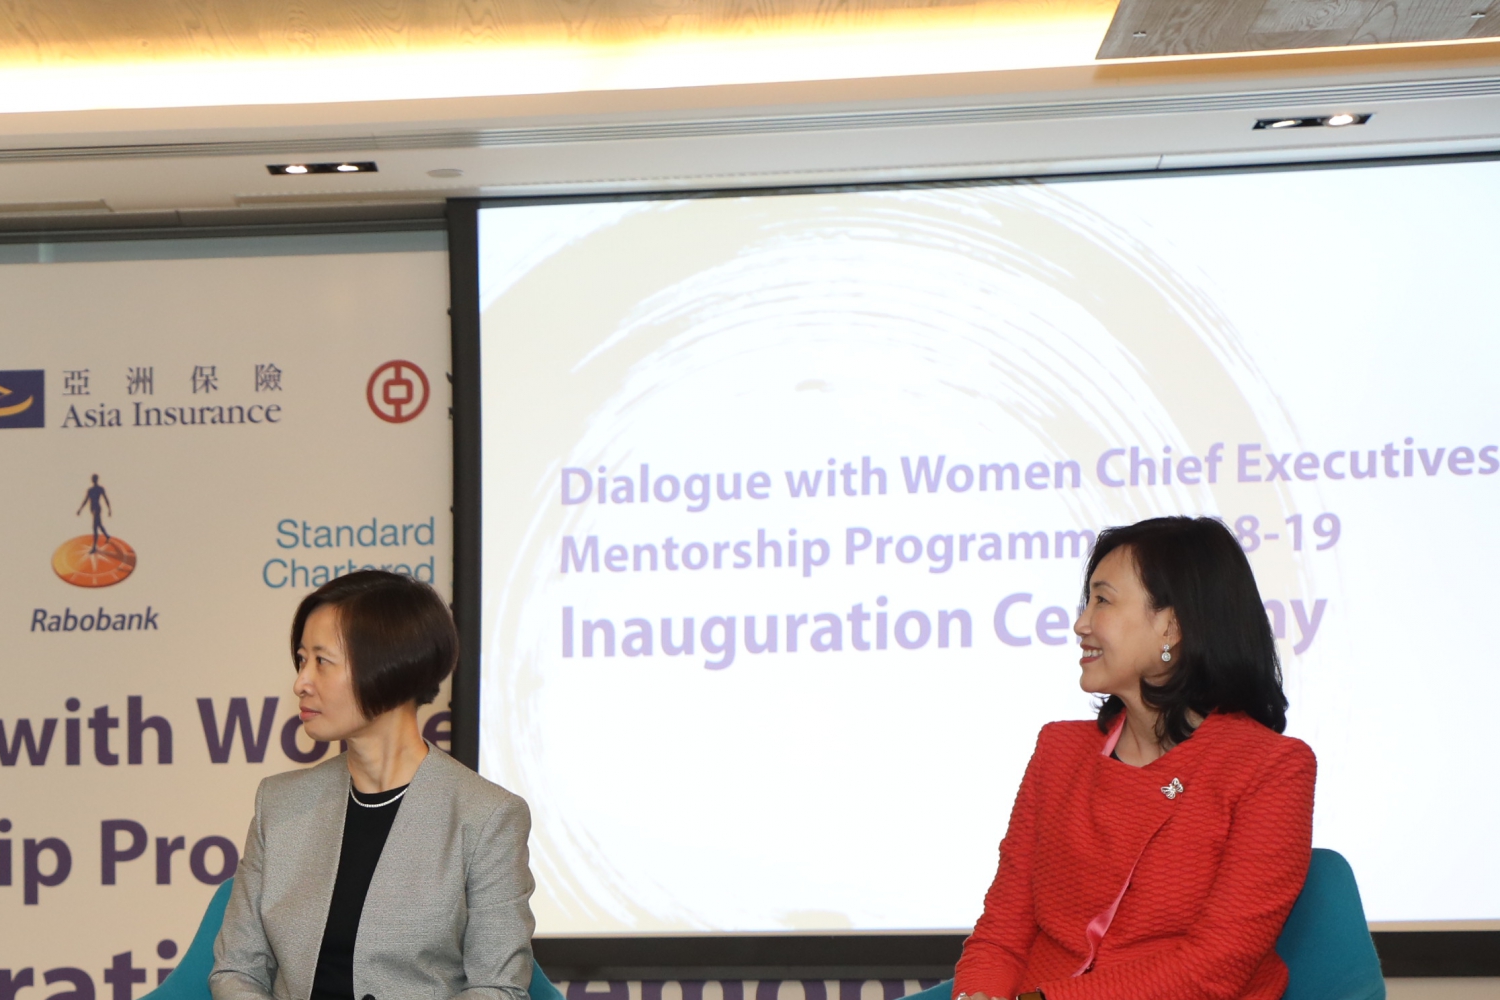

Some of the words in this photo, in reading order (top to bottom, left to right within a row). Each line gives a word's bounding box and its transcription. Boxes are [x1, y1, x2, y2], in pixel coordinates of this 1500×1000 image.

[61, 362, 283, 396] 亞洲保險
[60, 402, 123, 429] Asia
[132, 401, 282, 427] Insurance
[559, 462, 772, 513] Dialogue
[785, 455, 888, 499] with
[900, 453, 1082, 495] Women
[1096, 441, 1224, 488] Chief
[1237, 436, 1499, 483] Executives
[276, 515, 435, 550] Standard
[559, 527, 831, 578] Mentorship
[844, 526, 1097, 575] Programm
[1234, 511, 1342, 554] 8-19
[29, 606, 160, 633] Rabobank
[560, 594, 974, 671] Inauguration
